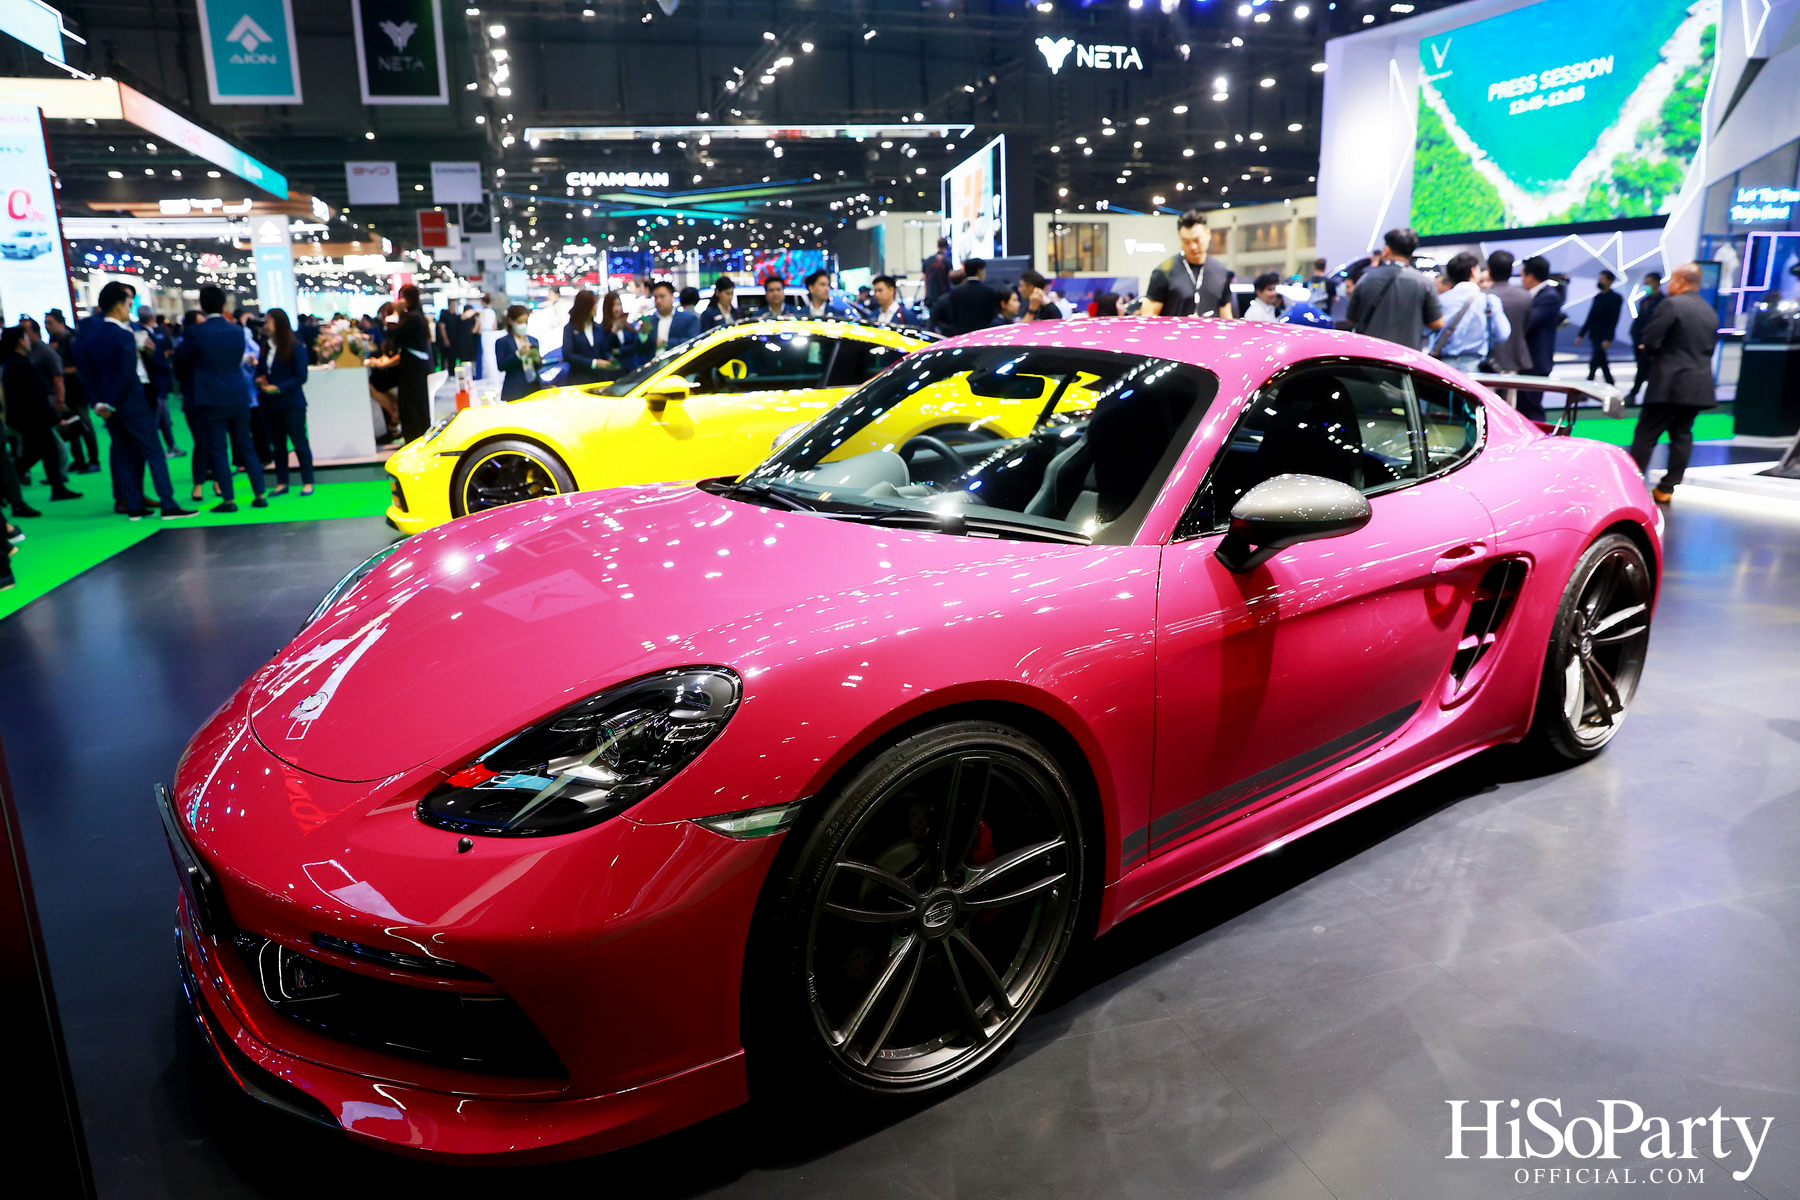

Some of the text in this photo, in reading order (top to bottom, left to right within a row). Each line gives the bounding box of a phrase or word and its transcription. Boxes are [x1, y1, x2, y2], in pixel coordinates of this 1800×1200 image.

[228, 53, 277, 65] AION
[378, 55, 426, 72] NETA
[1076, 44, 1144, 70] NETA
[1487, 54, 1615, 102] PRESS SESSION
[565, 171, 670, 187] CHANGAN
